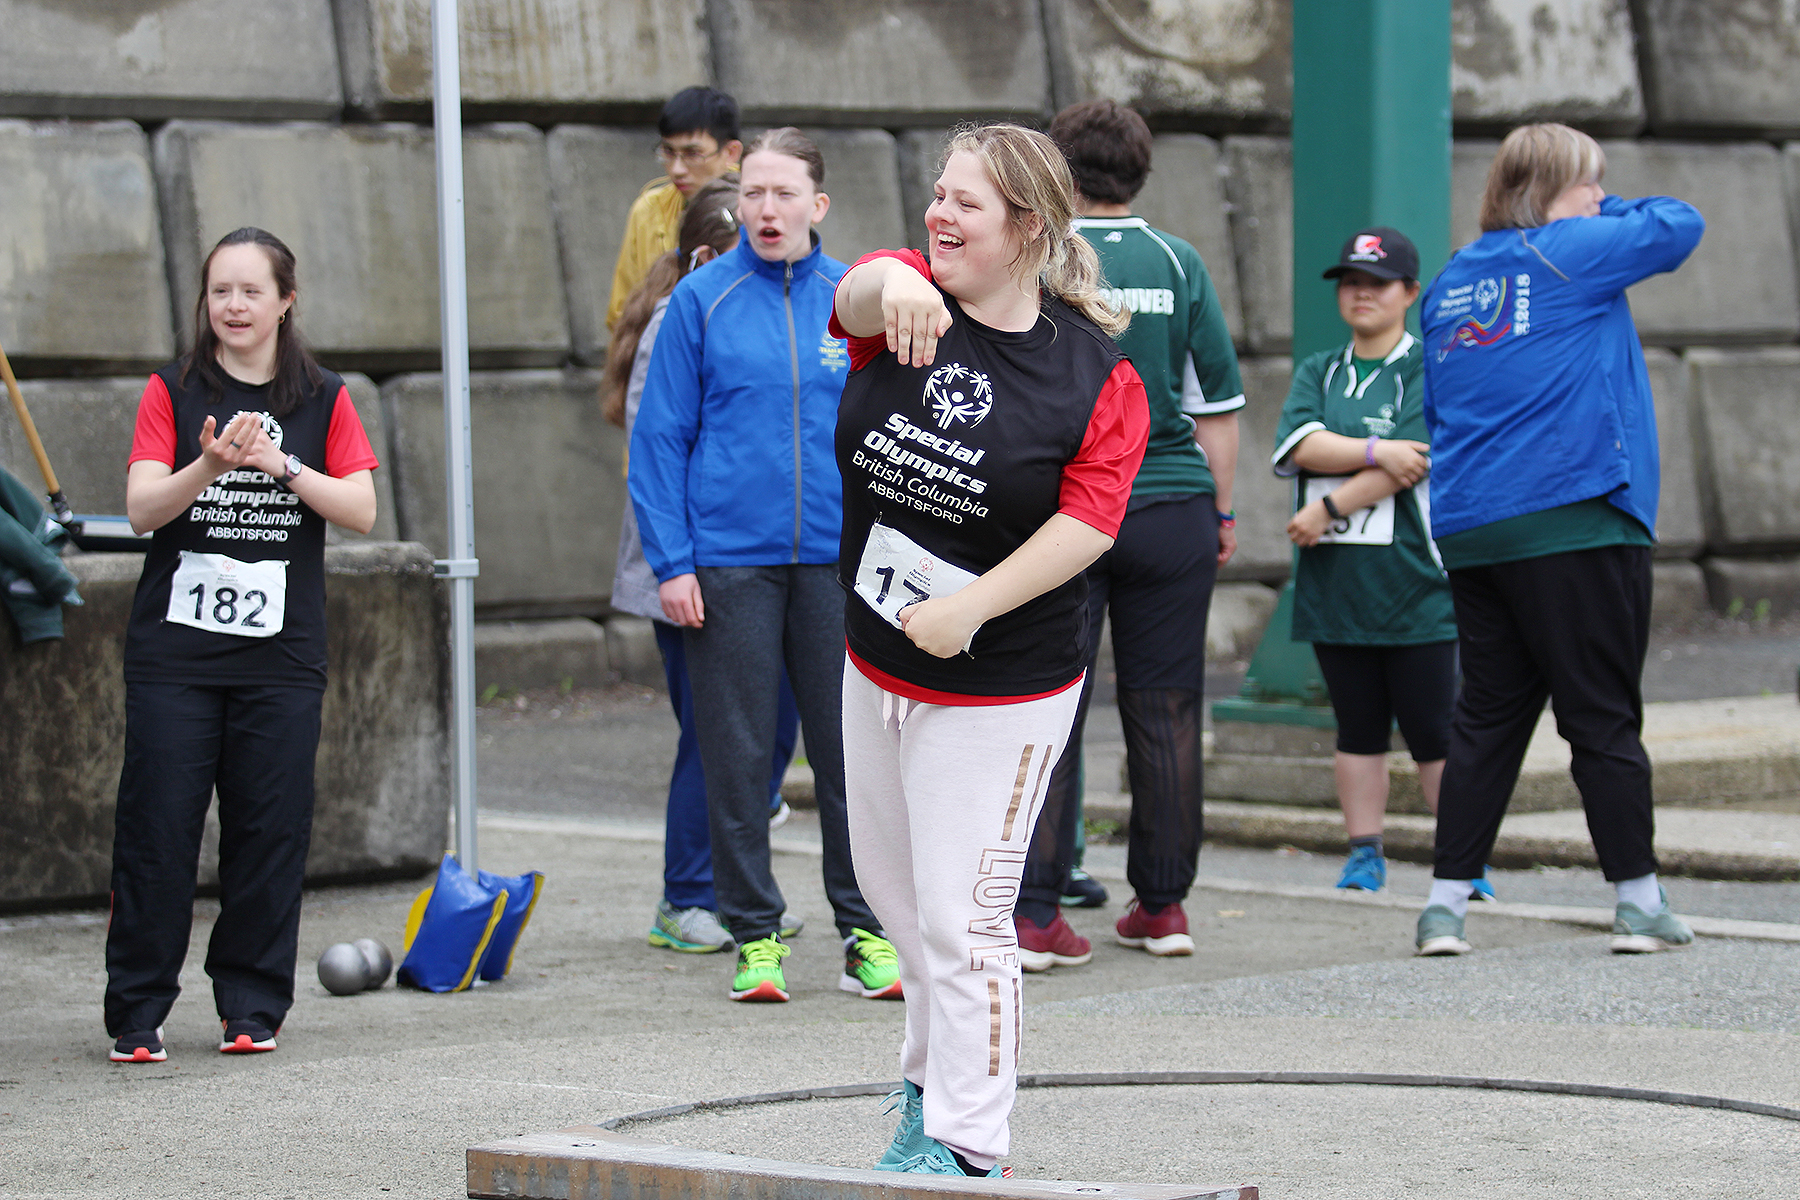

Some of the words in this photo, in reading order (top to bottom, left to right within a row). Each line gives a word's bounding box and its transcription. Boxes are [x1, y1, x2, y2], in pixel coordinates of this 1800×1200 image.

[1515, 273, 1531, 322] 2018
[863, 430, 988, 494] Olympics
[884, 412, 986, 466] Special
[852, 449, 904, 486] British
[907, 477, 989, 519] Columbia
[867, 480, 963, 525] ABBOTSFORD
[190, 507, 237, 523] British
[239, 509, 303, 527] Columbia
[206, 526, 289, 543] ABBOTSFORD
[188, 583, 268, 628] 182
[967, 848, 1027, 972] LOVE
